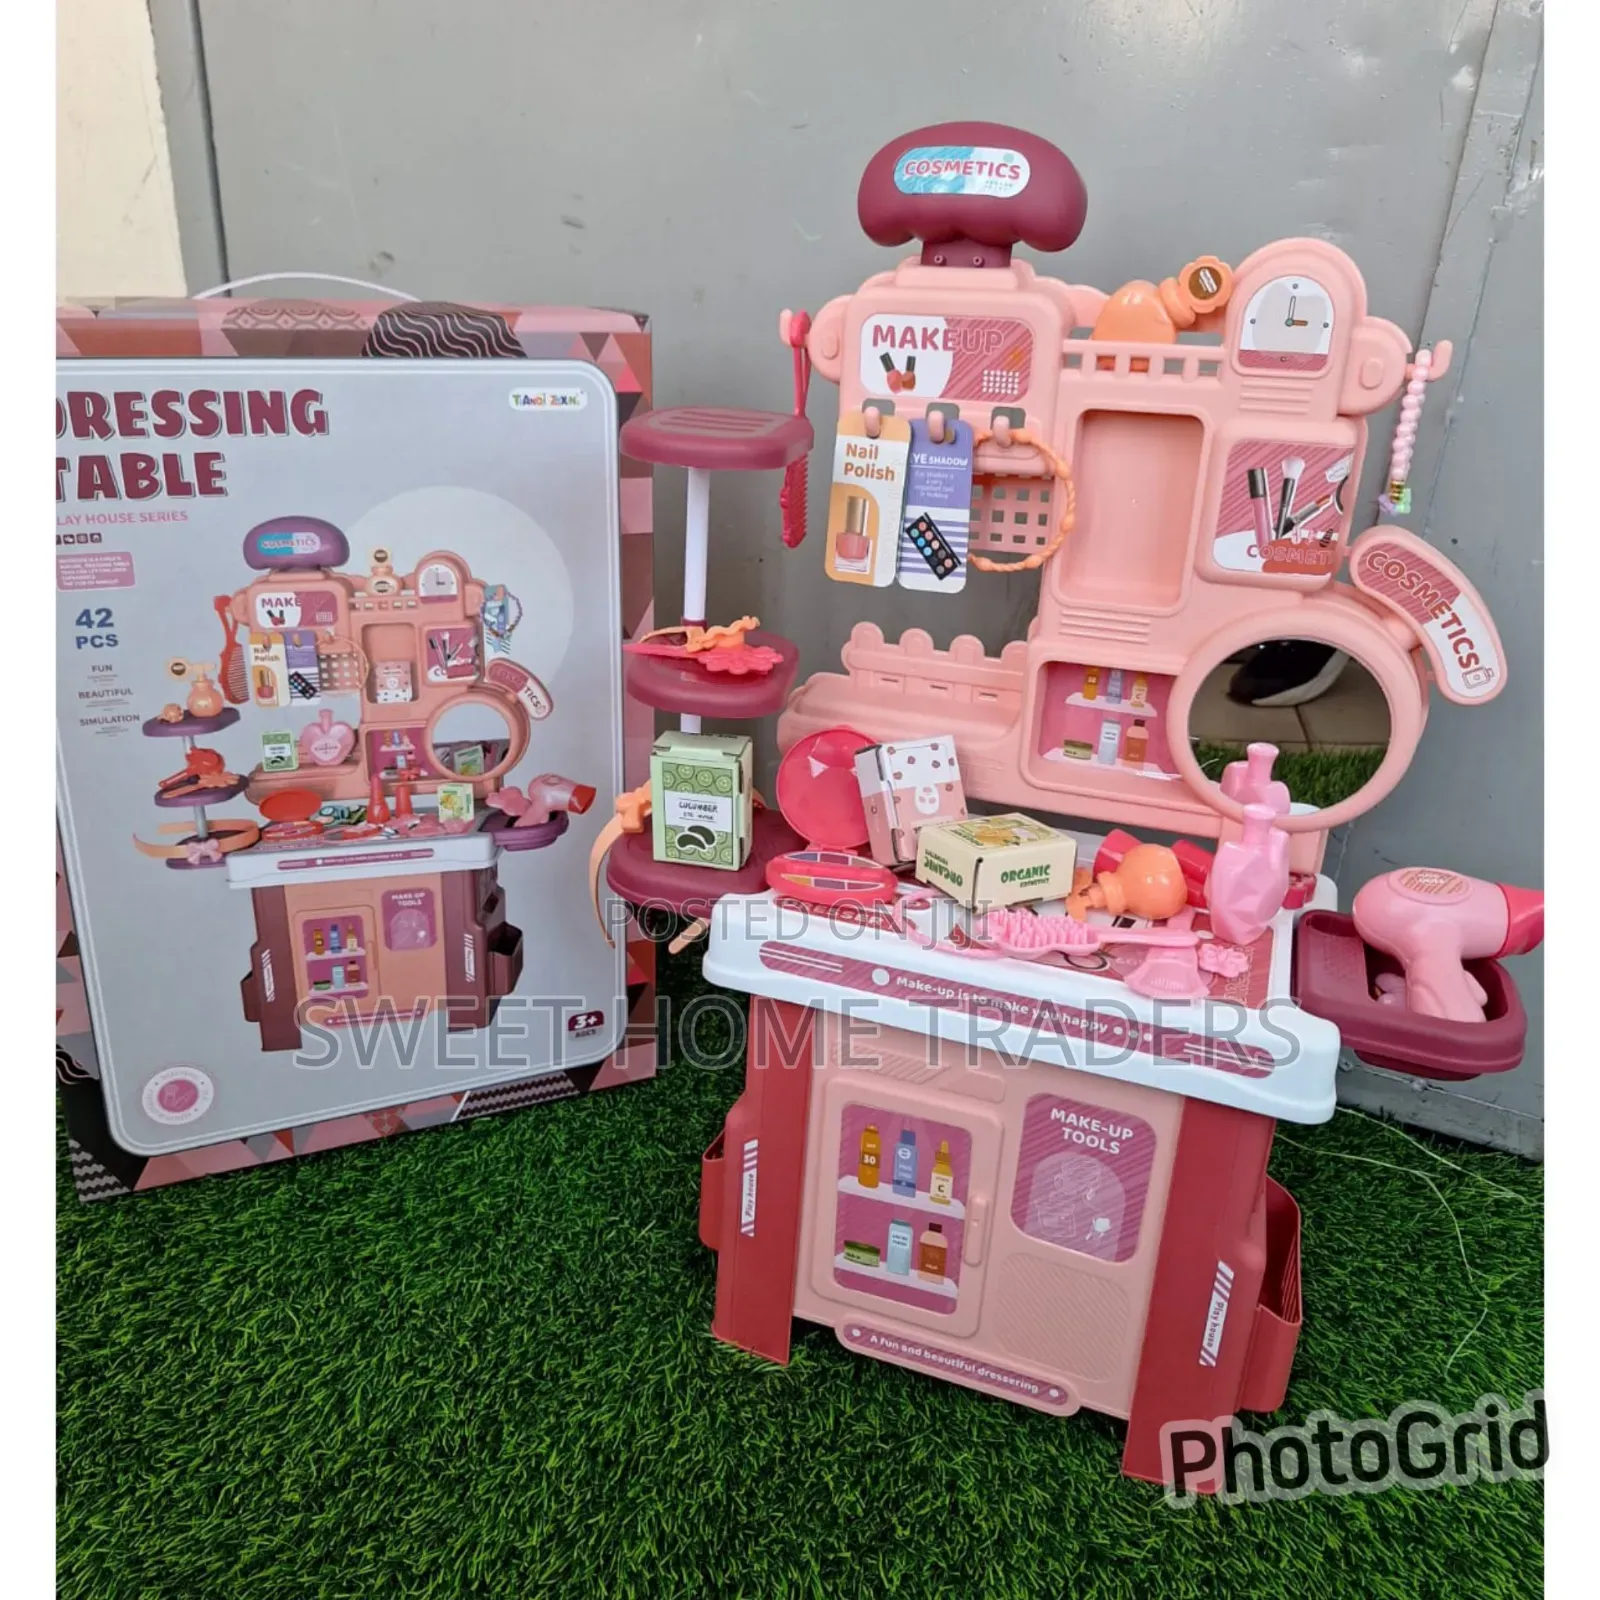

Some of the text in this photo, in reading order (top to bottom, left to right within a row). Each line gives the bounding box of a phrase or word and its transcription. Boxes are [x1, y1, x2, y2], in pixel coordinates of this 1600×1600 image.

[904, 159, 1021, 180] COSMETICS
[871, 324, 1004, 353] MAKEUP
[56, 389, 327, 439] RESSING
[845, 443, 879, 460] Nail
[911, 453, 968, 466] YE SHADOW
[843, 462, 895, 482] Polish
[87, 512, 137, 524] HOUSE
[139, 510, 189, 522] SERIES
[75, 608, 115, 629] 42
[1366, 550, 1480, 670] COSMETICS
[75, 633, 119, 650] PCS
[91, 664, 113, 672] FUN
[78, 688, 134, 700] BEAUTIFUL
[79, 714, 141, 727] SIMULATION
[678, 800, 718, 812] CUCUMBER
[923, 855, 963, 887] ORGANIC
[1000, 863, 1051, 884] ORGANIC
[896, 976, 954, 999] Make-up
[957, 989, 969, 1001] is
[972, 993, 988, 1005] to
[990, 997, 1029, 1014] make
[1061, 1010, 1108, 1033] happy
[574, 1014, 598, 1029] 3+
[1050, 1107, 1134, 1141] MAKE-UP
[1061, 1126, 1121, 1155] TOOLS
[869, 1334, 879, 1344] A
[901, 1342, 922, 1356] and
[923, 1346, 976, 1373] beautiful
[977, 1366, 1039, 1395] dressering
